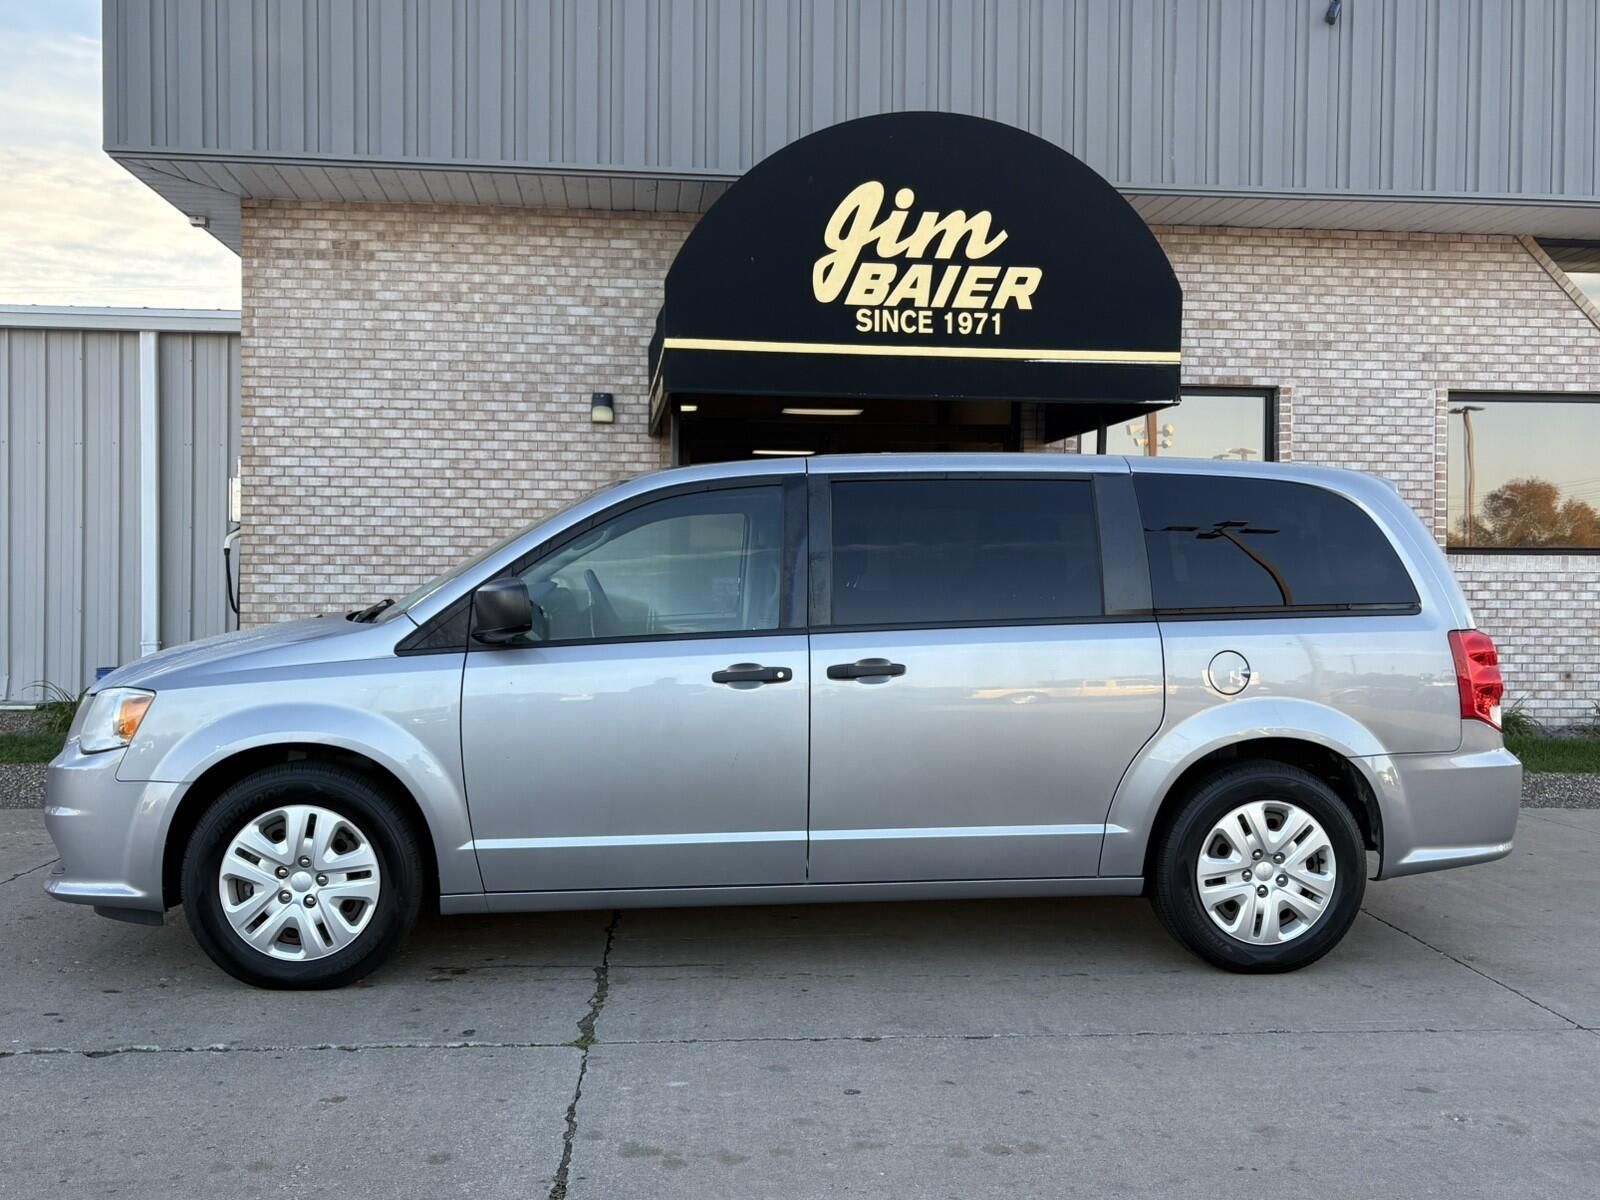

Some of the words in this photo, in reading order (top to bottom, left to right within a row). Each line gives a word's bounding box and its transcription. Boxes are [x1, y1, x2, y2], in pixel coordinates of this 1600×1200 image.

[812, 180, 1008, 303] Jim
[844, 262, 1043, 310] BAIER
[855, 308, 934, 334] SINCE
[944, 311, 1001, 336] 1971
